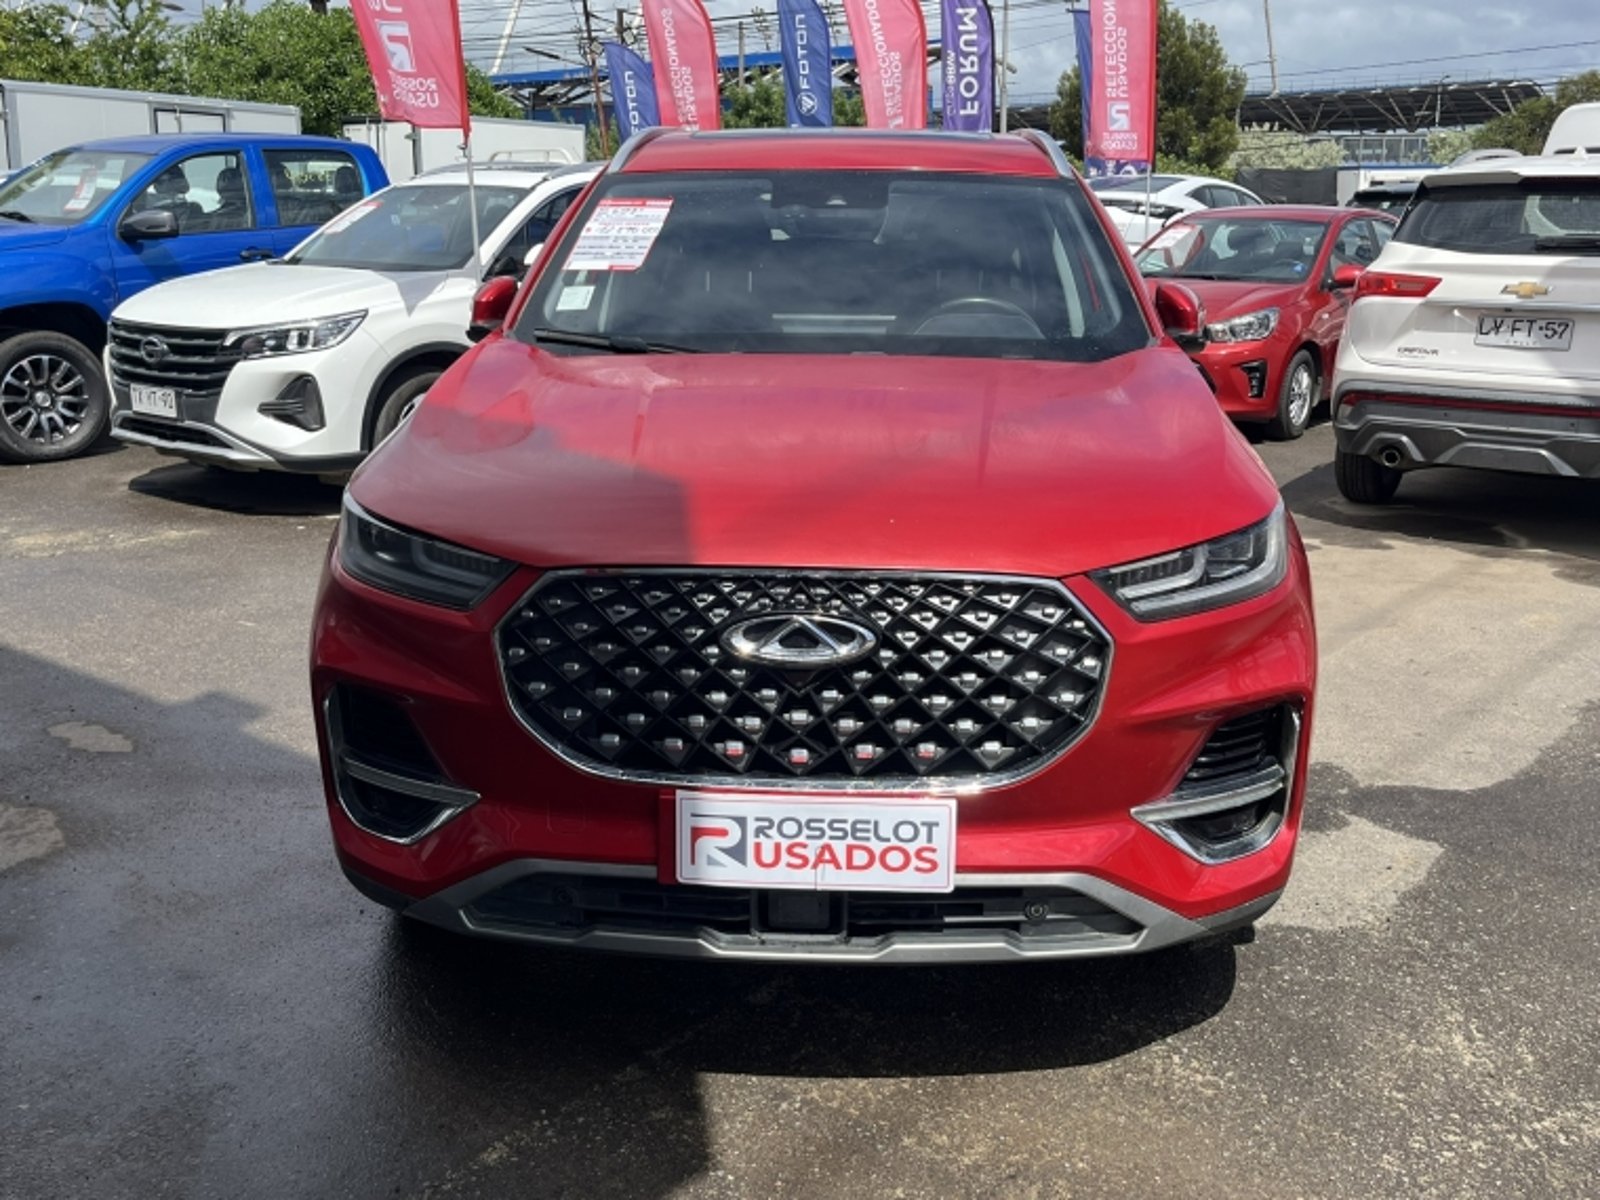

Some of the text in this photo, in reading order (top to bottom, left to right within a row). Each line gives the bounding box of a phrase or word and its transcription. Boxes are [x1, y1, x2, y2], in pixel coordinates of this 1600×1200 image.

[795, 13, 811, 90] FOTON
[754, 817, 940, 844] ROSSELOT
[753, 842, 940, 874] USADOS
